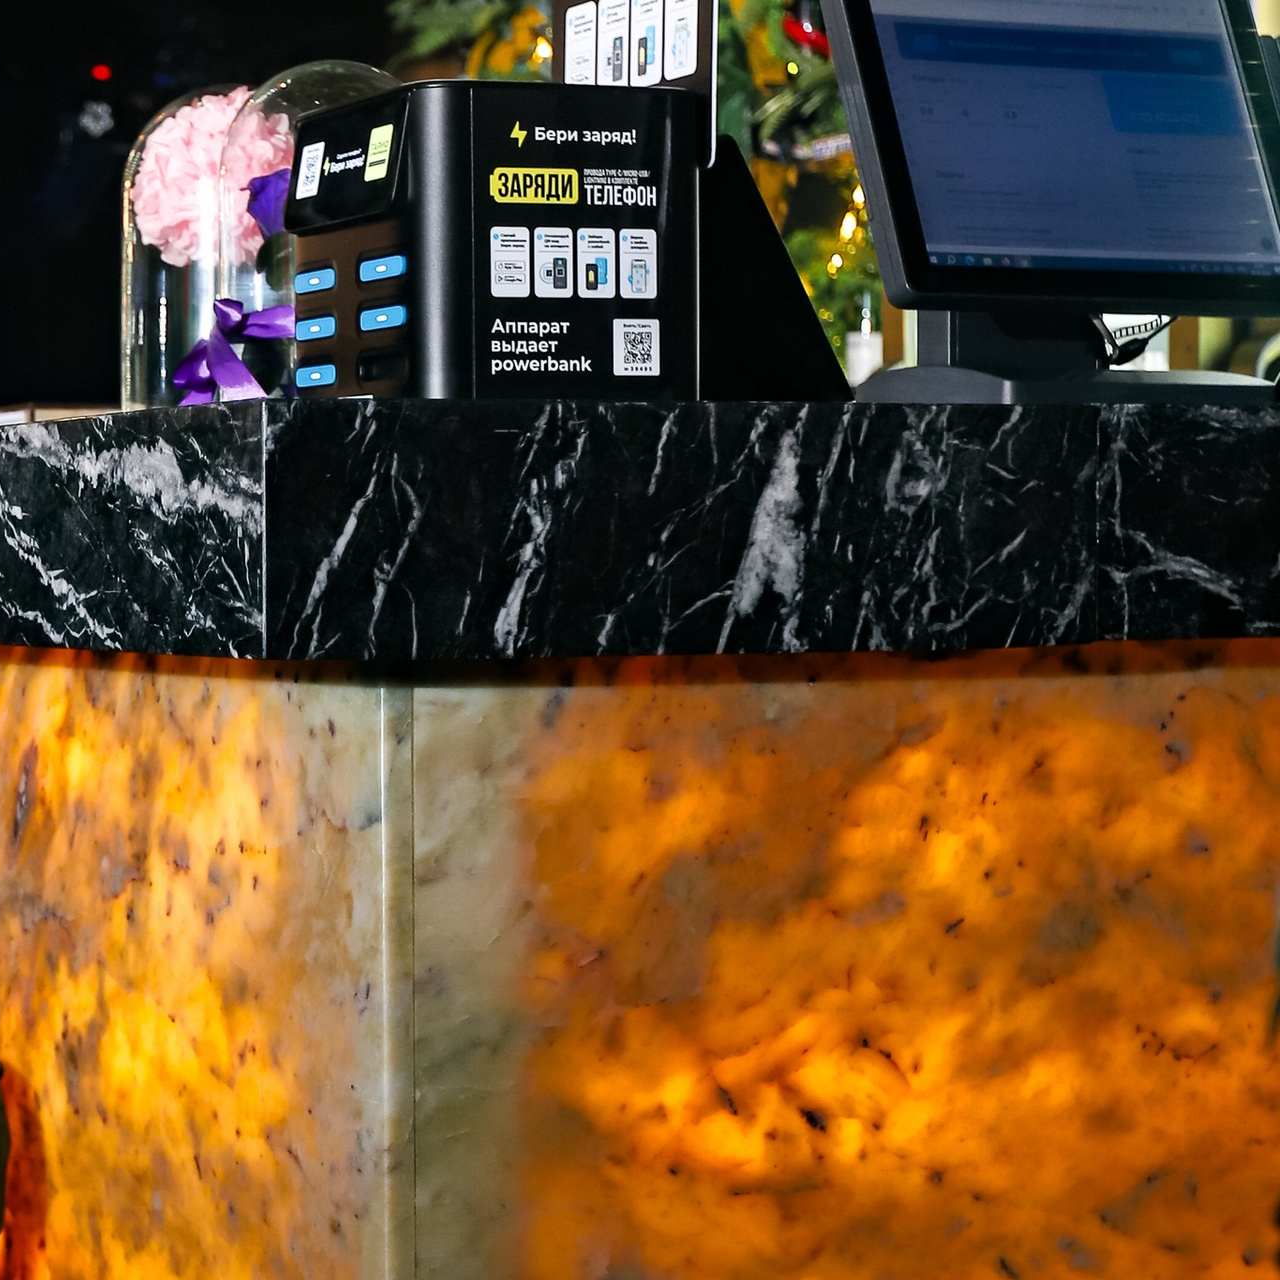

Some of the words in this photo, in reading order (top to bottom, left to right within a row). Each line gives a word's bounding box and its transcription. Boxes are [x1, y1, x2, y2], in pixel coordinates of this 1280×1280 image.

[535, 126, 578, 145] Бери
[582, 129, 637, 146] заряд!
[498, 173, 573, 201] ЗАРЯДИ
[584, 185, 657, 207] ТЕЛЕФОН
[491, 318, 570, 337] Аппарат
[491, 340, 558, 355] выдает
[491, 356, 592, 375] powerbank
